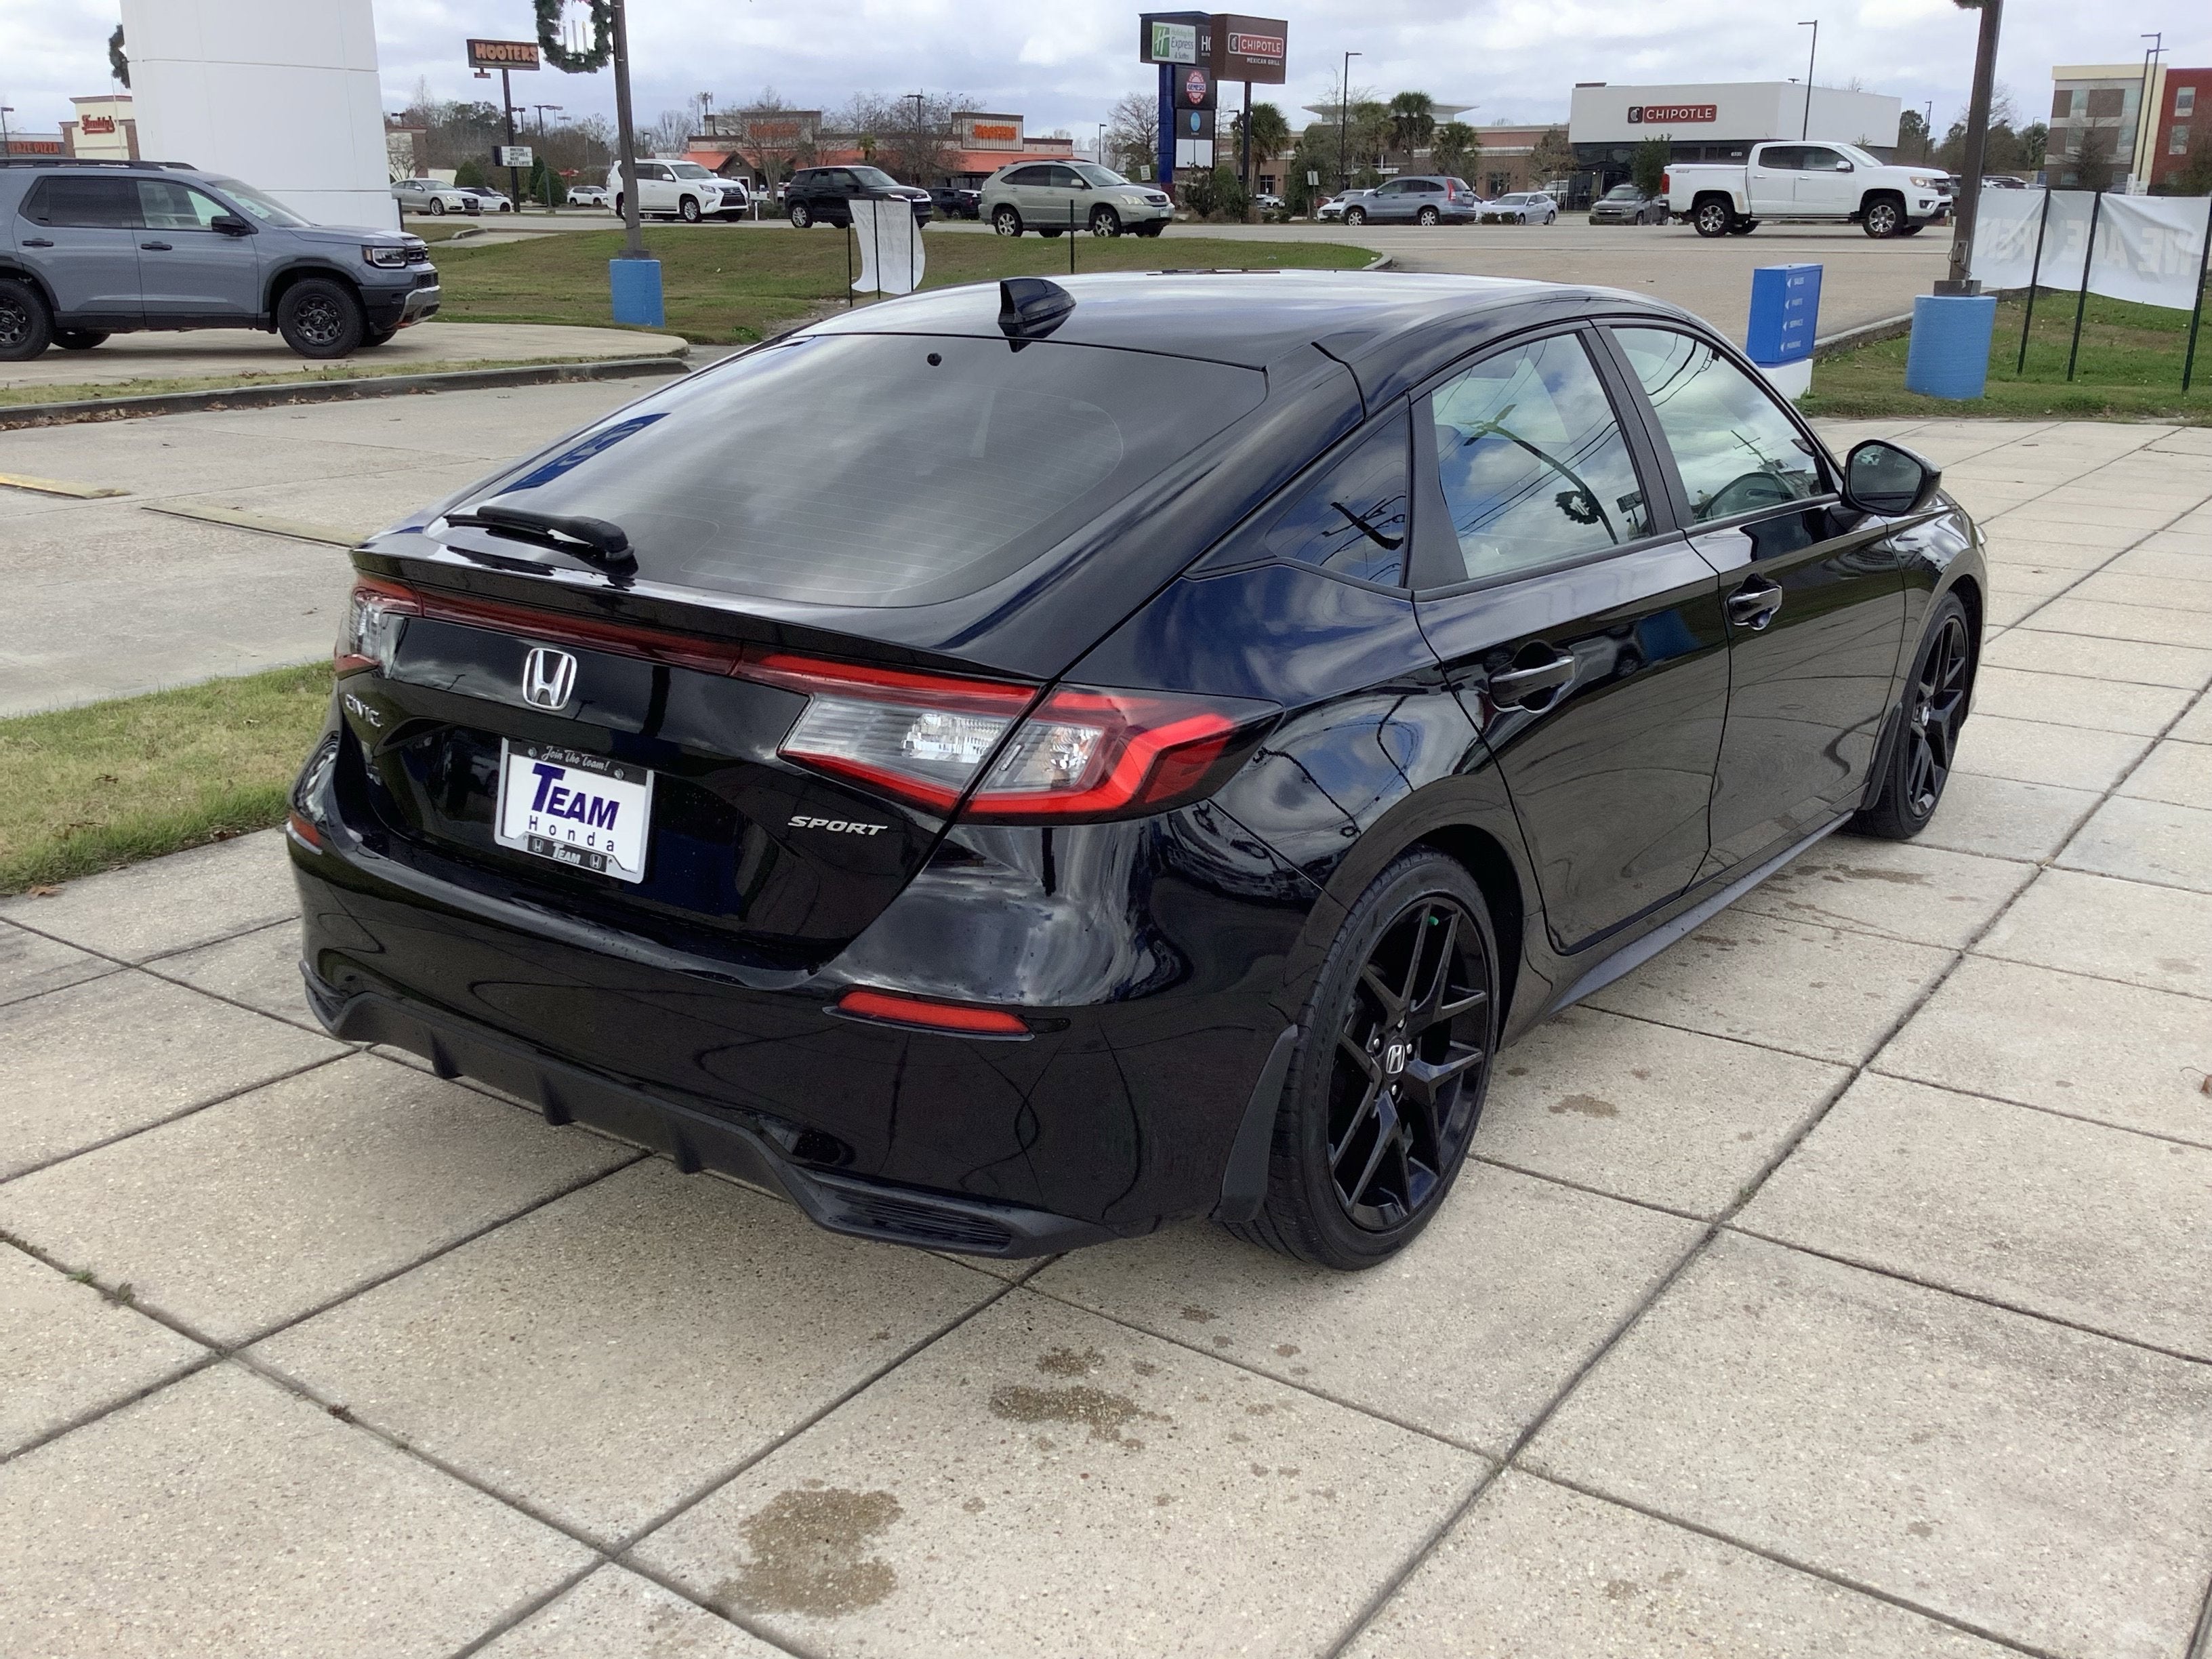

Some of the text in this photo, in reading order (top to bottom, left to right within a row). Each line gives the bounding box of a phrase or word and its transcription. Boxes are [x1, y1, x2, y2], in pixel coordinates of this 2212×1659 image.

[475, 43, 538, 62] HOOTERS
[1171, 37, 1194, 52] Express
[1241, 39, 1282, 53] CHIPOTLE
[1246, 57, 1267, 65] MEXICAN
[1646, 108, 1713, 119] CHIPOTLE
[33, 142, 60, 154] PIZZA
[541, 745, 611, 771] Join The Team!
[531, 762, 620, 831] TEAM
[529, 815, 615, 852] Honda
[787, 815, 888, 836] SPORT
[552, 842, 581, 865] TEAM
